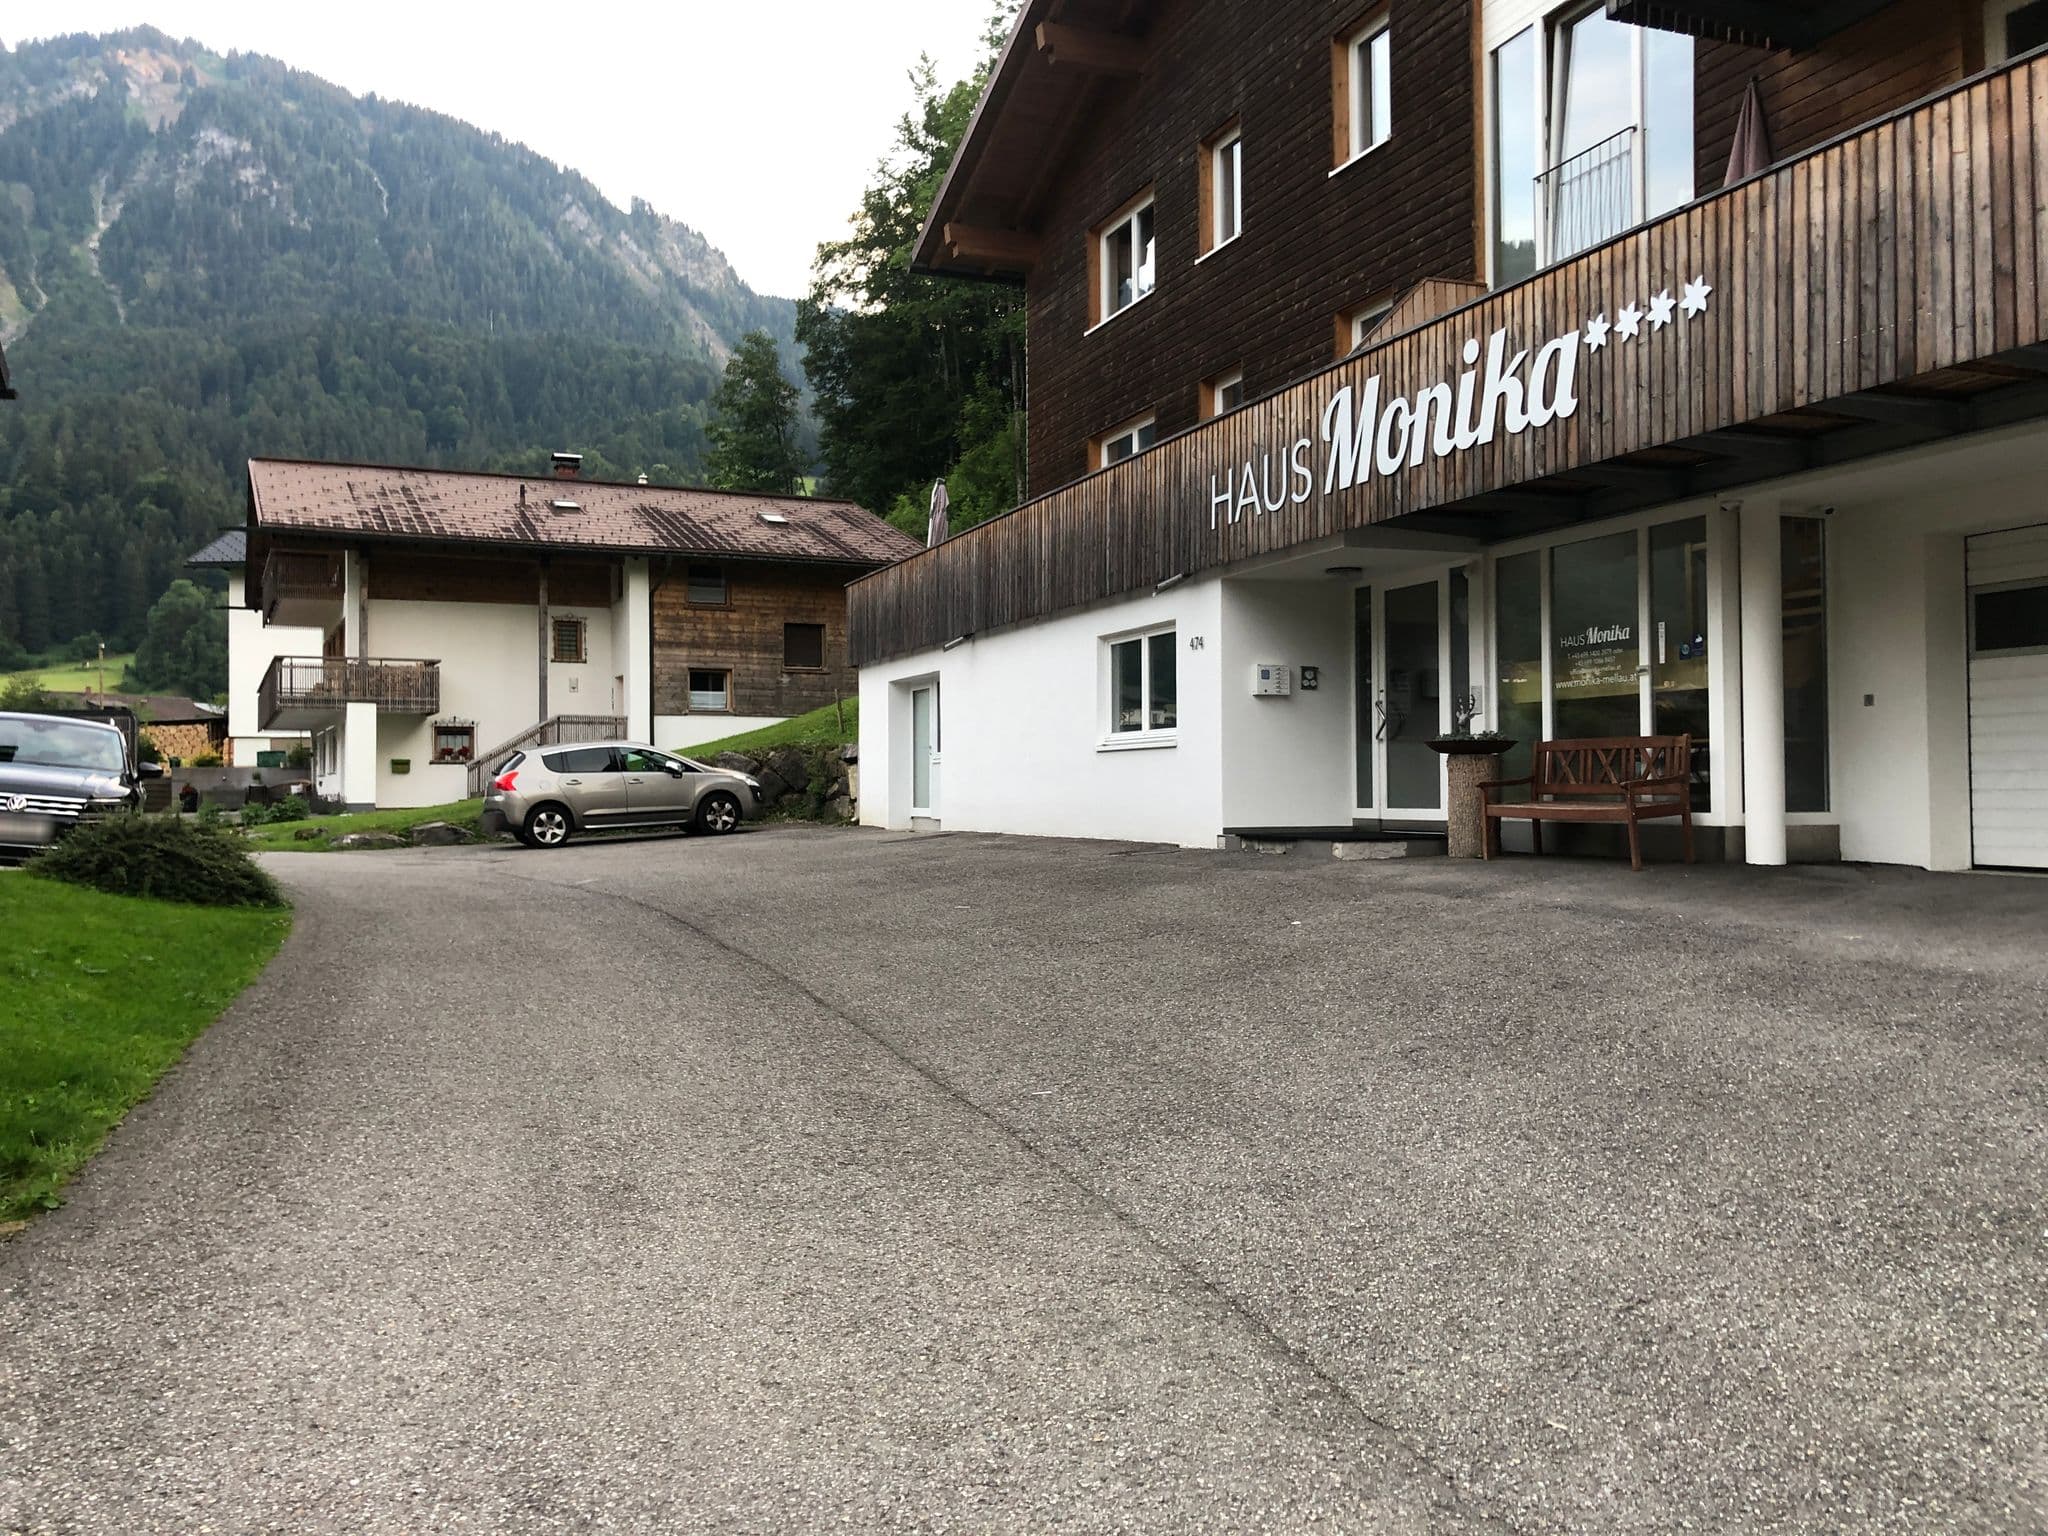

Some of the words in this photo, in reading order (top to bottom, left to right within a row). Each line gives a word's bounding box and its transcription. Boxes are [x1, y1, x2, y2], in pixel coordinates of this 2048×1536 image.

[1211, 438, 1313, 530] HAUS
[1321, 327, 1581, 495] Monika
[1190, 636, 1204, 650] 474
[1560, 634, 1585, 648] HAUS
[1586, 625, 1630, 644] Monika
